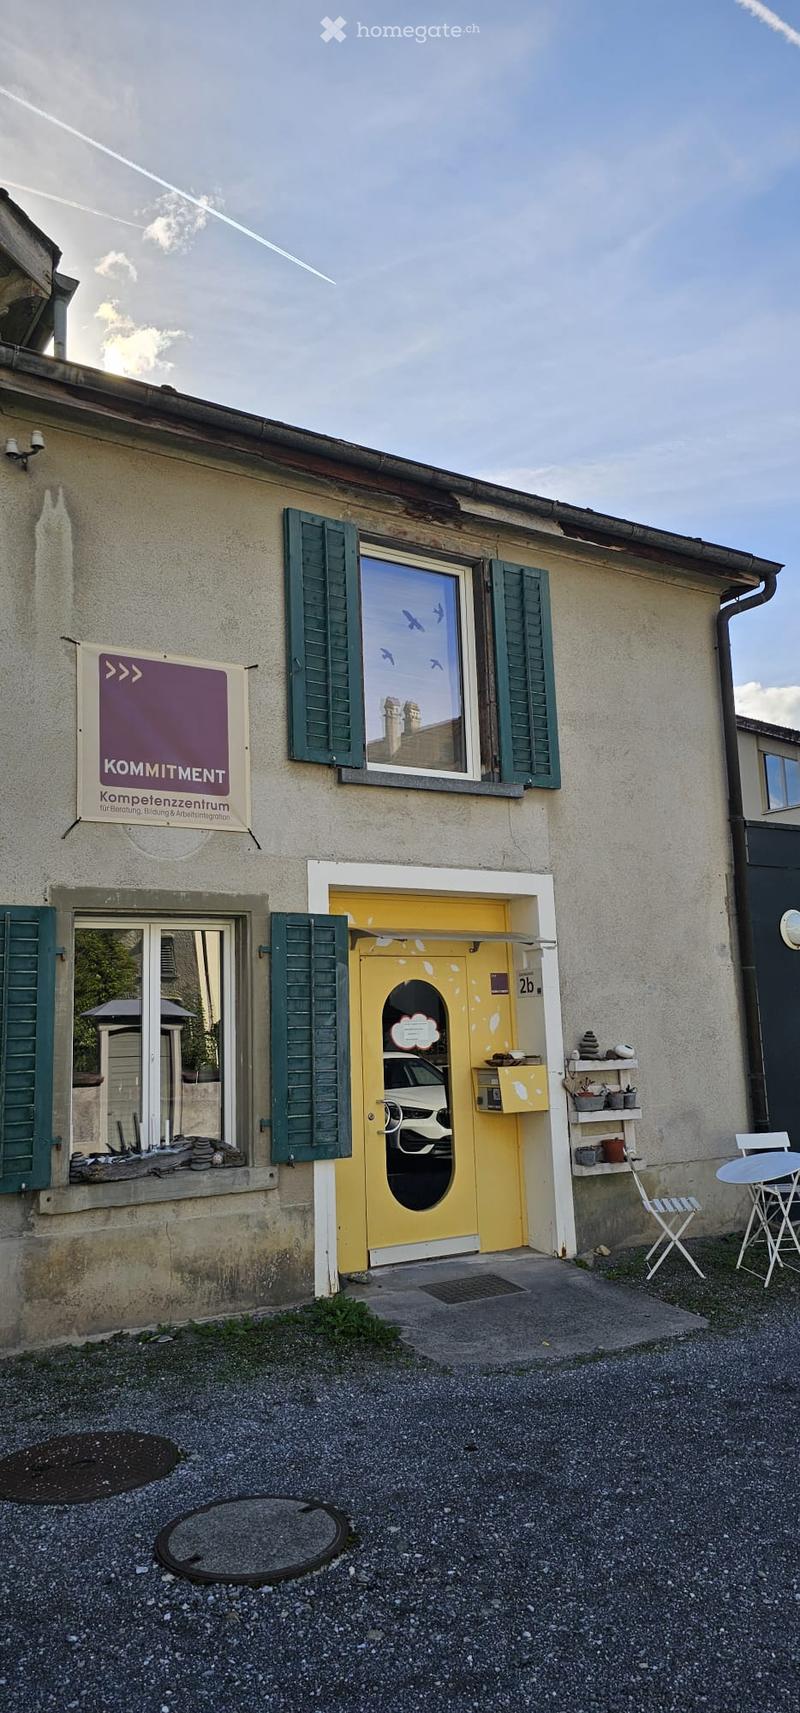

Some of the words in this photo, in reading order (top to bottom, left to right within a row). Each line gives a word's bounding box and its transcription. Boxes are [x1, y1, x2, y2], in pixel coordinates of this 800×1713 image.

[104, 758, 226, 784] KOMMITMENT
[100, 791, 230, 812] Kompetenzzentrum
[100, 804, 109, 812] für
[110, 805, 142, 816] Beratung,
[144, 808, 170, 818] Bildung
[176, 810, 230, 821] Arbeitsintegration
[519, 976, 534, 994] 2b
